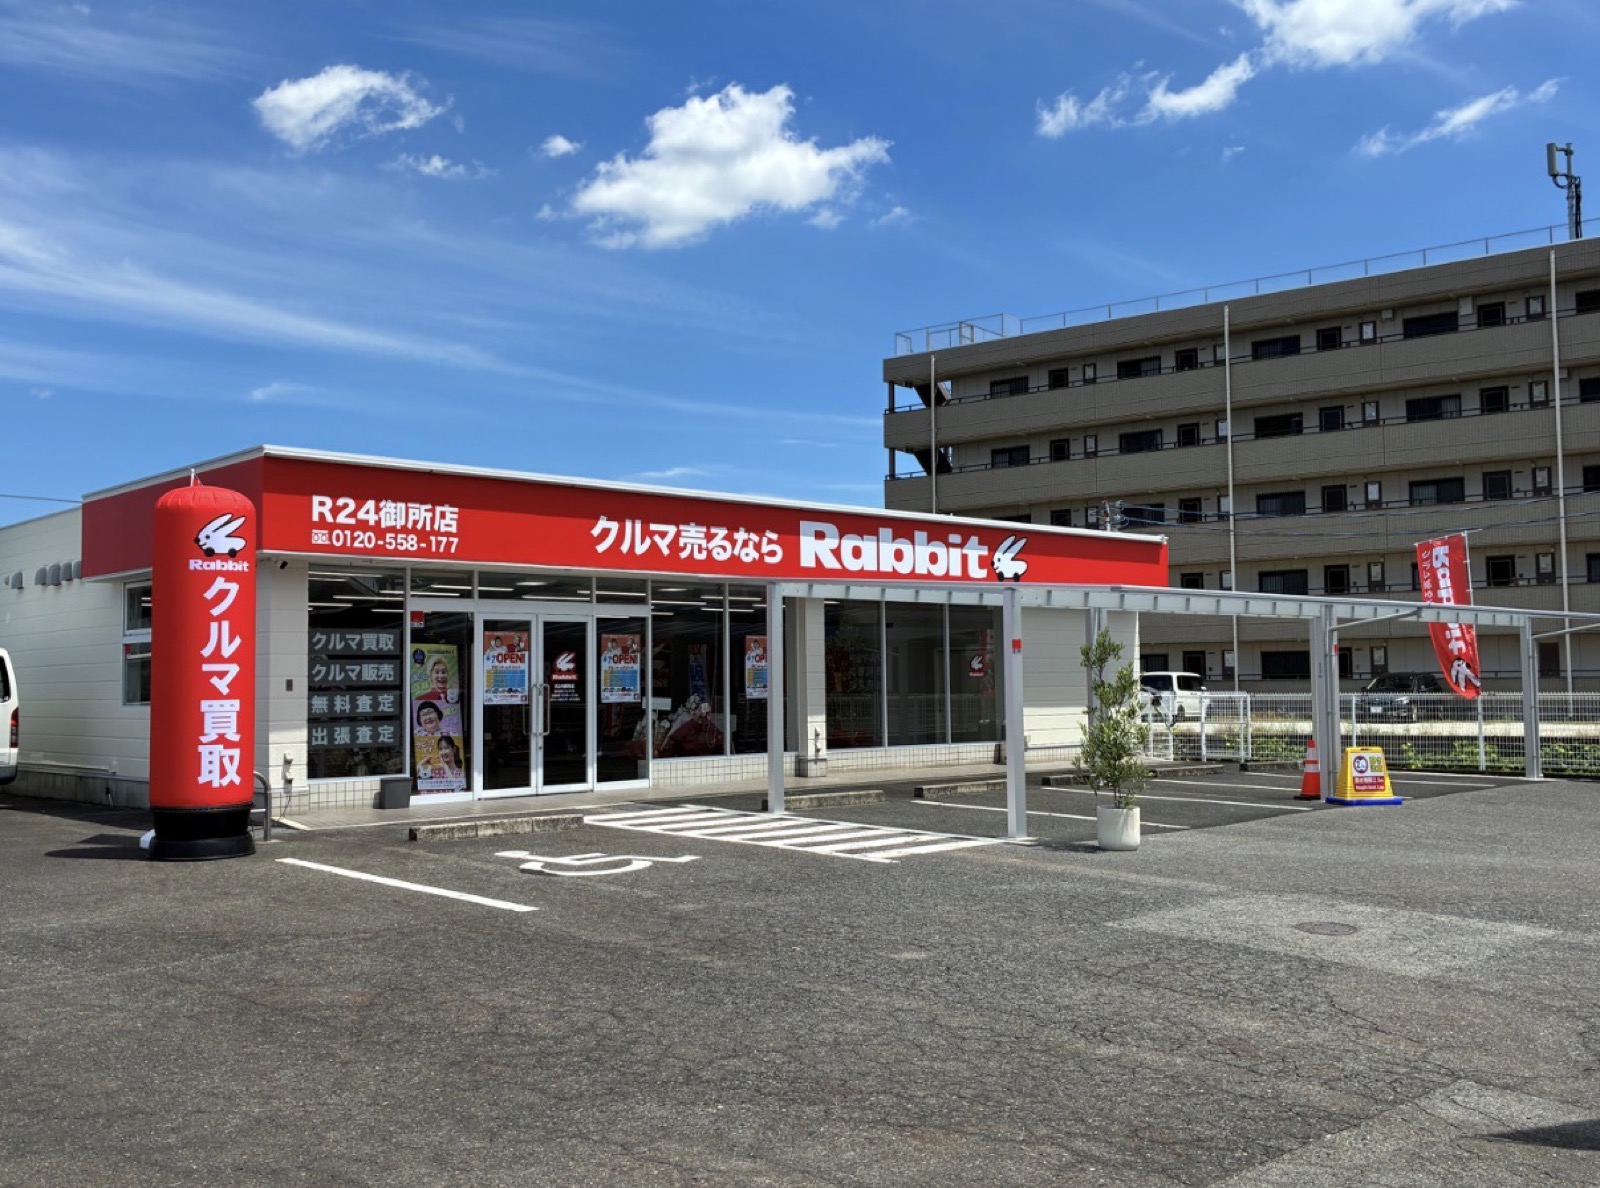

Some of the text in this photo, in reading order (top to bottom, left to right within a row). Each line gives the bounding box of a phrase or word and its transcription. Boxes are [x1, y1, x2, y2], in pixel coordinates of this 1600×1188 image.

[312, 494, 459, 533] R24御所店
[332, 529, 459, 553] 0120-558-177
[590, 515, 784, 563] クルマ売るなら
[800, 520, 989, 578] Rabbit
[188, 559, 250, 572] Rabbit
[311, 632, 394, 651] クルマ買取
[198, 576, 242, 788] クルマ買取
[311, 663, 394, 682] クルマ販売
[311, 694, 394, 713] 無料査定
[311, 726, 394, 745] 出張査定
